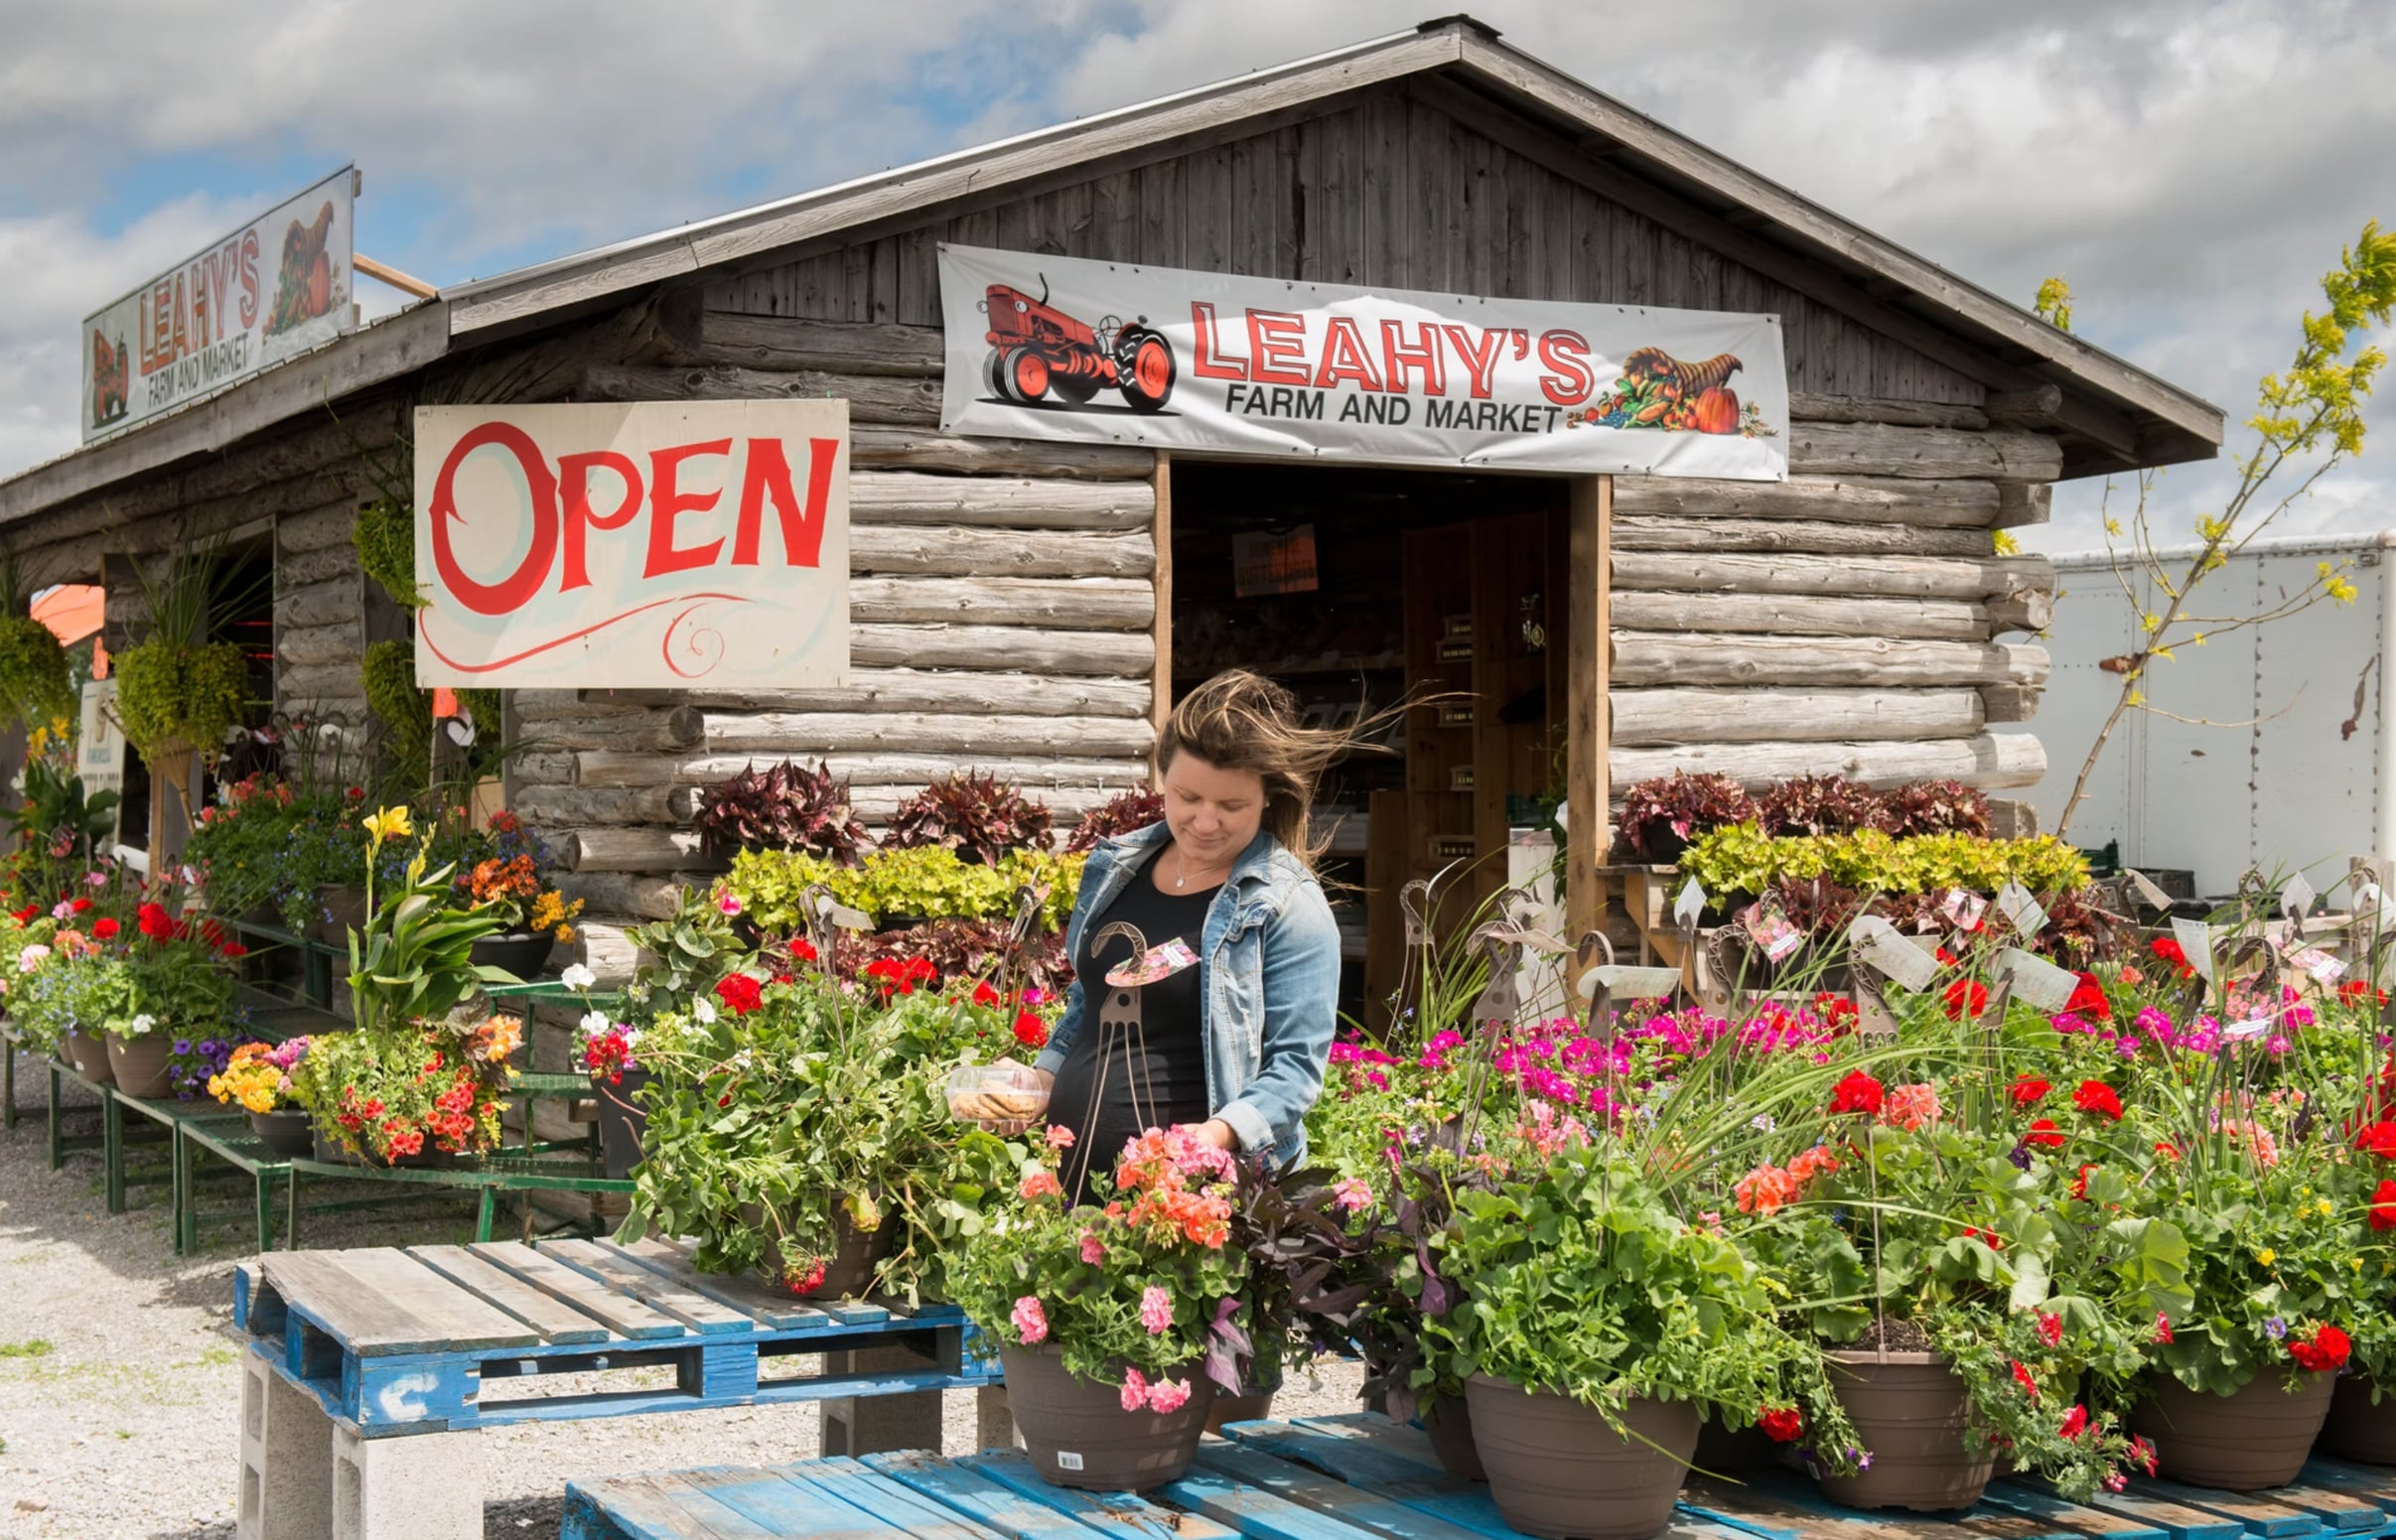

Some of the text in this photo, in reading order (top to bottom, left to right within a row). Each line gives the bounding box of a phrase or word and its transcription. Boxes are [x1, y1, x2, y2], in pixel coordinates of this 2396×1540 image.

[139, 228, 260, 377] LEAHY'S
[1192, 301, 1595, 406] LEAHY'S
[149, 332, 249, 408] FARM AND MARKET
[1226, 383, 1563, 434] FARM AND MARKET
[428, 421, 840, 616] OPEN
